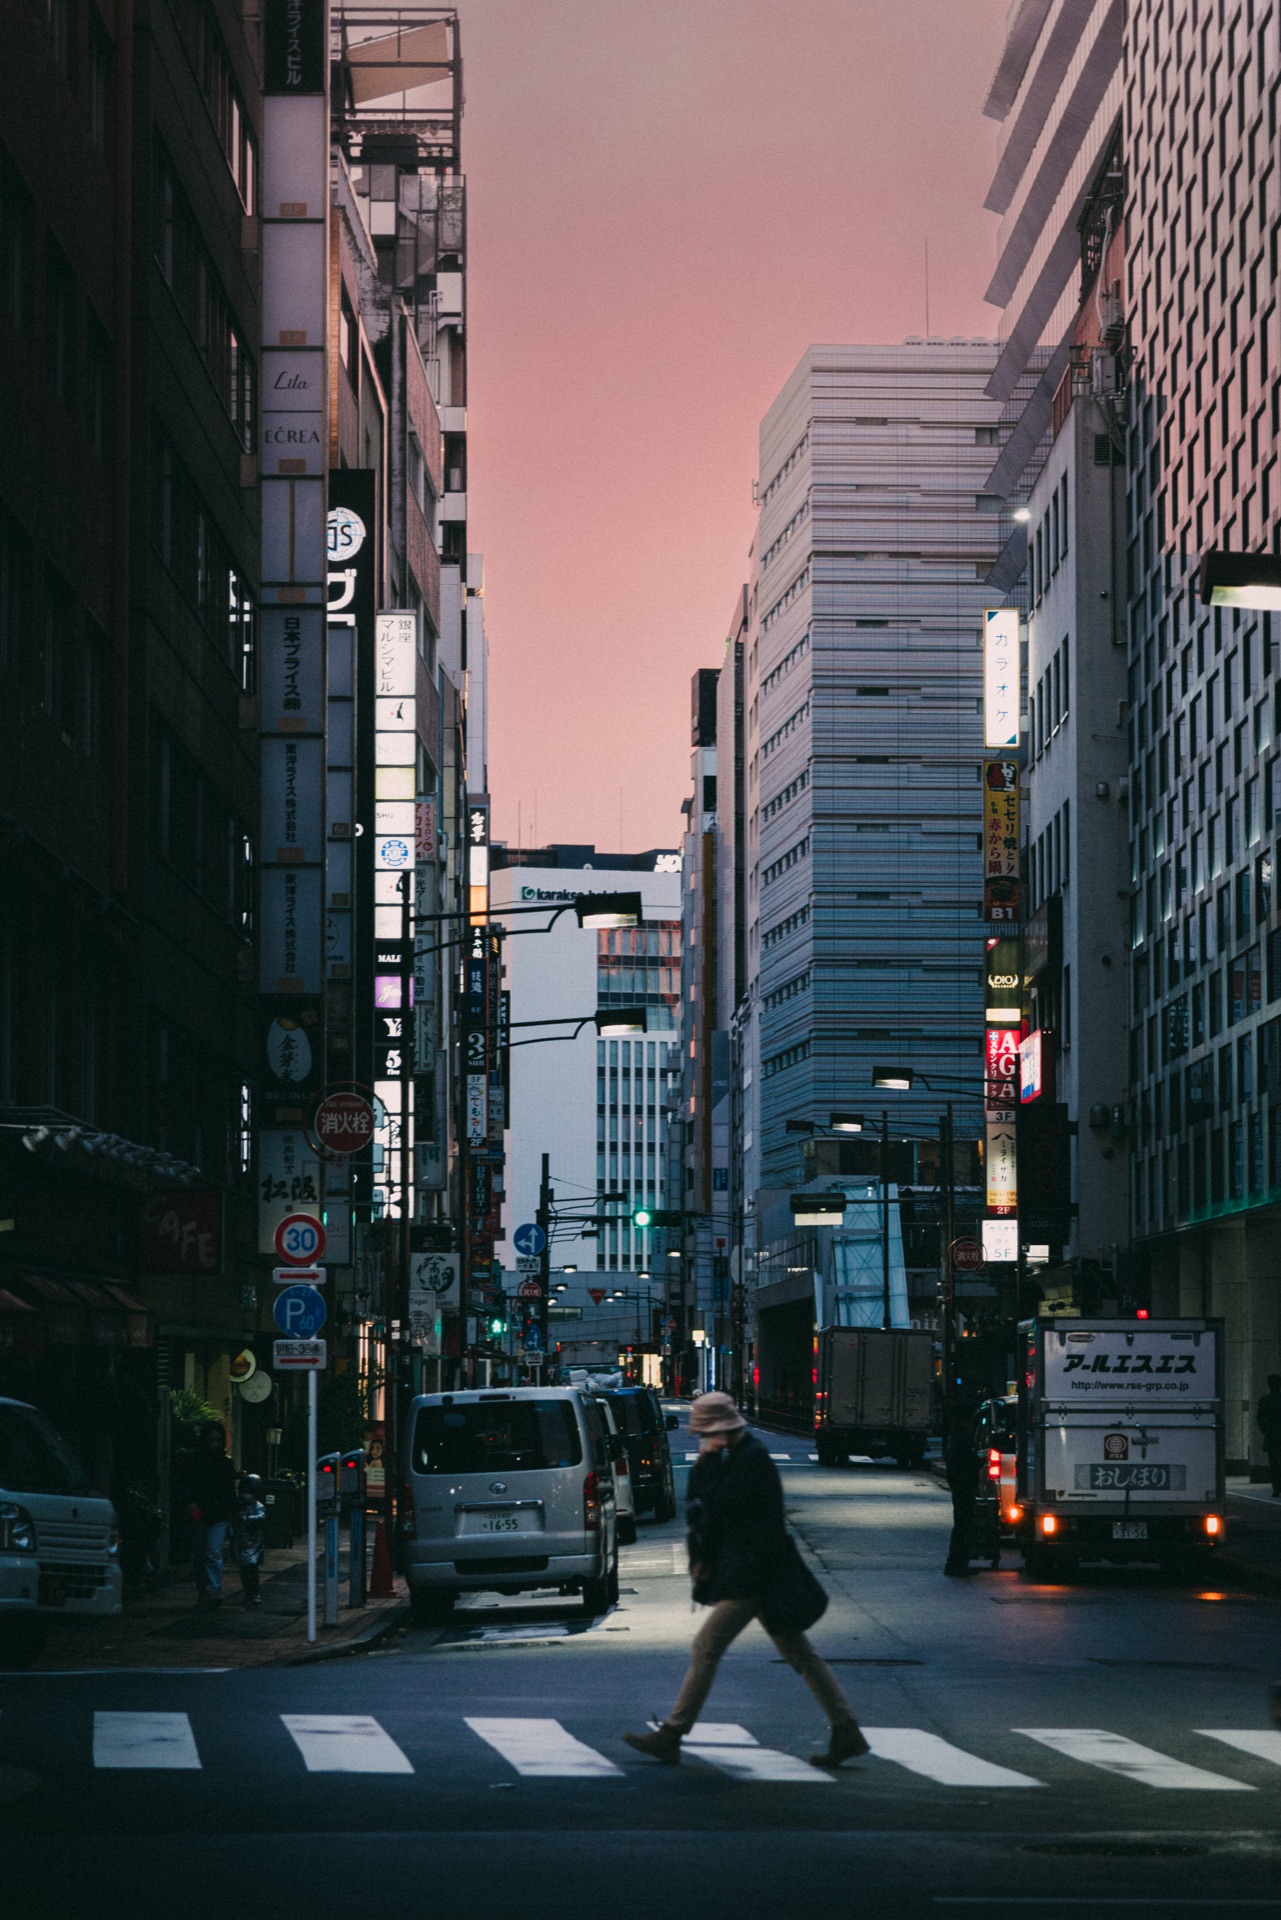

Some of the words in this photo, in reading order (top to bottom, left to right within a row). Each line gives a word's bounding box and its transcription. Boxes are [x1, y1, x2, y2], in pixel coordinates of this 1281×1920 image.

[273, 371, 309, 390] Lila
[399, 620, 412, 642] 銀座
[380, 620, 394, 692] マルシマビル
[995, 633, 1009, 723] カラオケ
[988, 818, 1002, 874] 赤から鍋
[991, 907, 1013, 919] B1
[321, 1111, 370, 1134] 消火栓
[470, 1097, 481, 1137] てもみん
[995, 1112, 1012, 1121] 3F
[469, 1139, 483, 1147] 2F
[475, 1165, 487, 1207] BRIGHT
[996, 1207, 1011, 1215] 2F
[143, 1194, 217, 1268] CAFE
[286, 1228, 315, 1251] 30
[956, 1251, 980, 1262] 消火栓
[995, 1248, 1011, 1258] 5F
[286, 1298, 306, 1329] P
[299, 1315, 314, 1329] 60
[1062, 1354, 1198, 1374] アールエスエス
[1071, 1381, 1189, 1392] http://www.rss-grp.co.jp
[1094, 1467, 1167, 1488] おしぼり
[489, 1519, 518, 1531] 16-55
